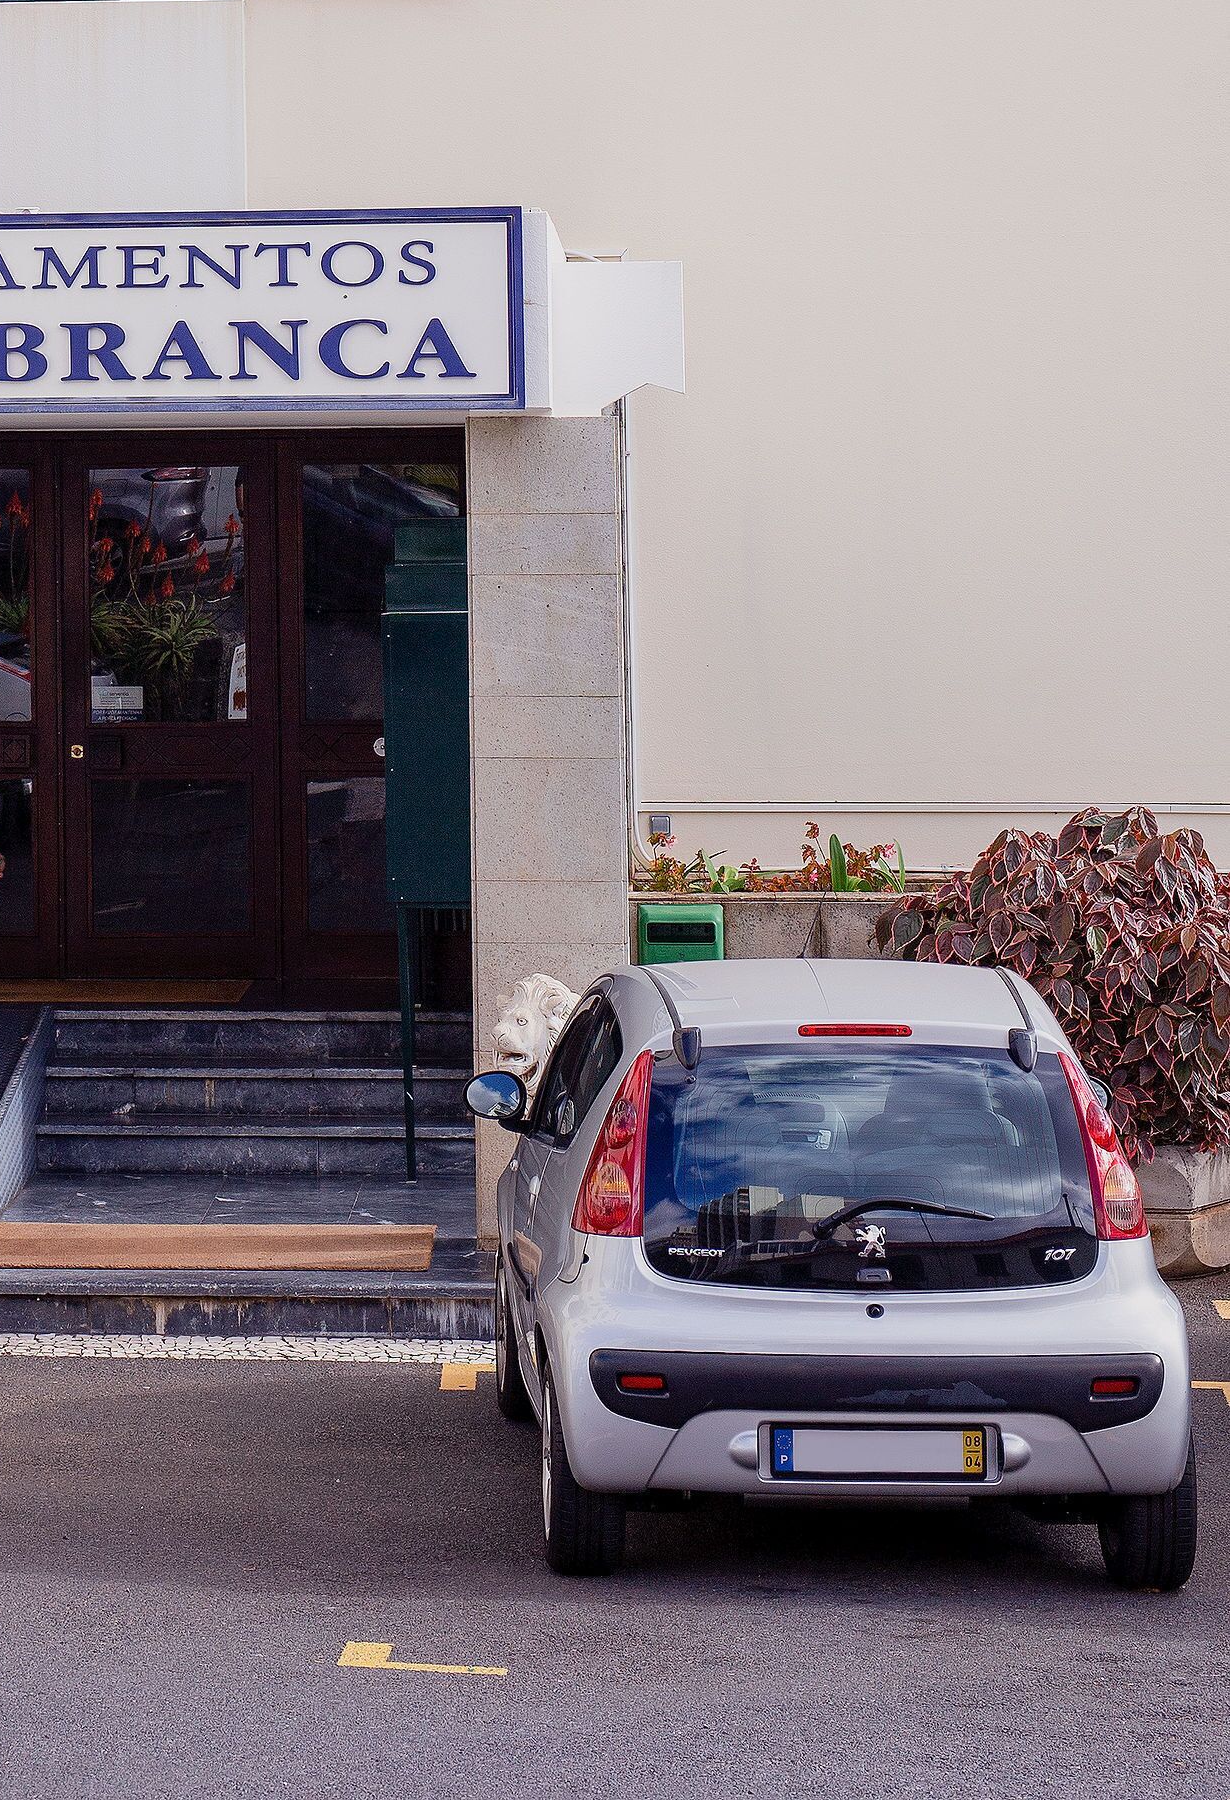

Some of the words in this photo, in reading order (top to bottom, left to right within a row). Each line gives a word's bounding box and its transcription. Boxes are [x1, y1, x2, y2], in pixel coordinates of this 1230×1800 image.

[668, 1247, 726, 1258] PEUGEOT
[1044, 1247, 1077, 1261] 107
[965, 1435, 981, 1447] 08
[780, 1454, 789, 1465] P
[965, 1456, 981, 1468] 04
